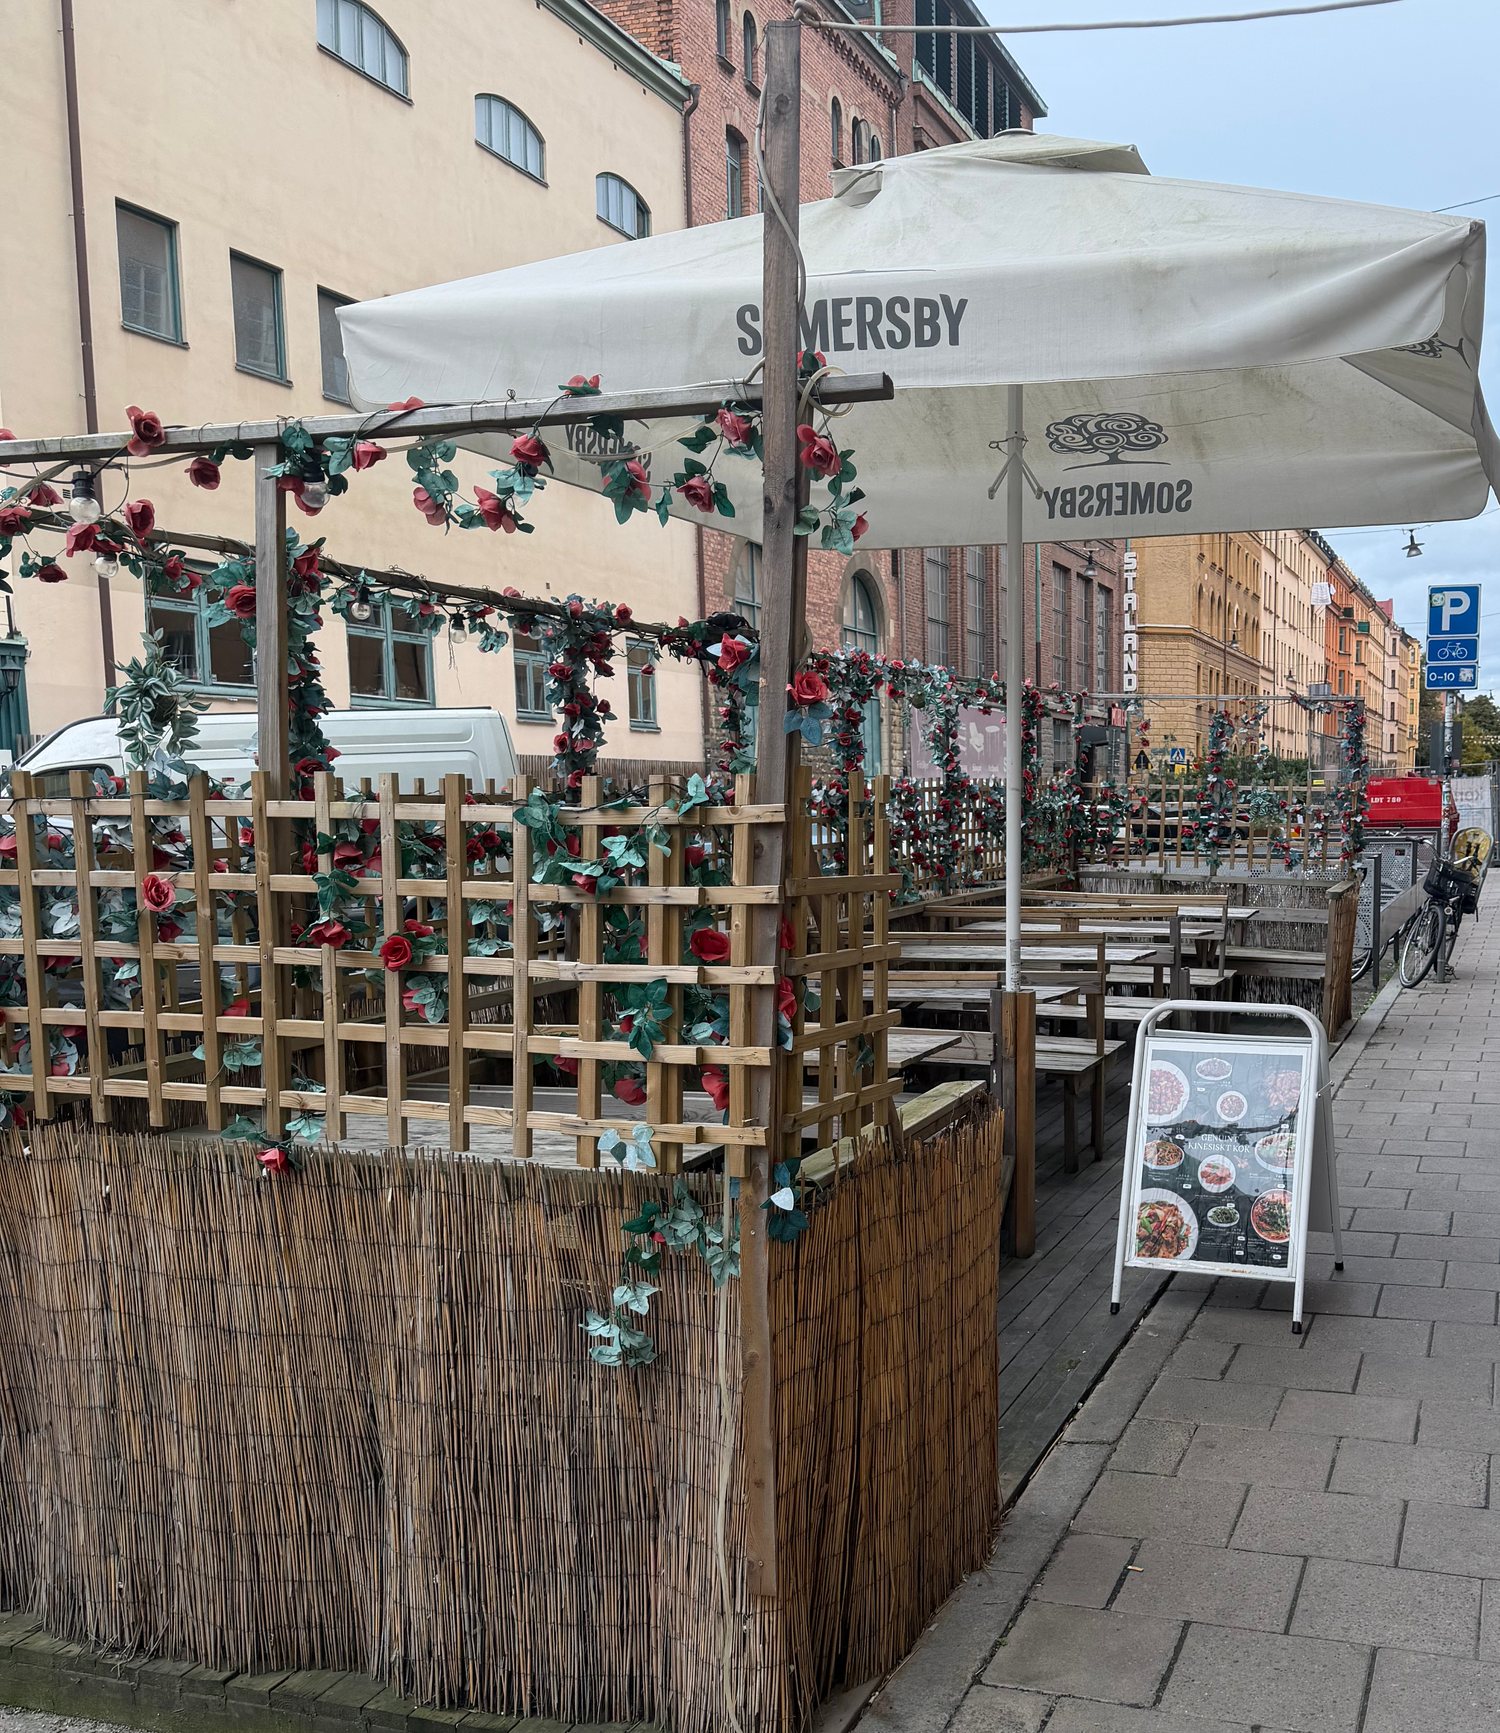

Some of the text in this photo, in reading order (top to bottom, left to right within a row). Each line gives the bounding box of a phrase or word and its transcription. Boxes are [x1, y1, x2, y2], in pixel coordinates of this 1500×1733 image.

[735, 294, 968, 356] SMERSBY
[1124, 552, 1137, 692] STALAND
[1441, 590, 1471, 631] P
[1188, 1142, 1231, 1152] KINESISKT
